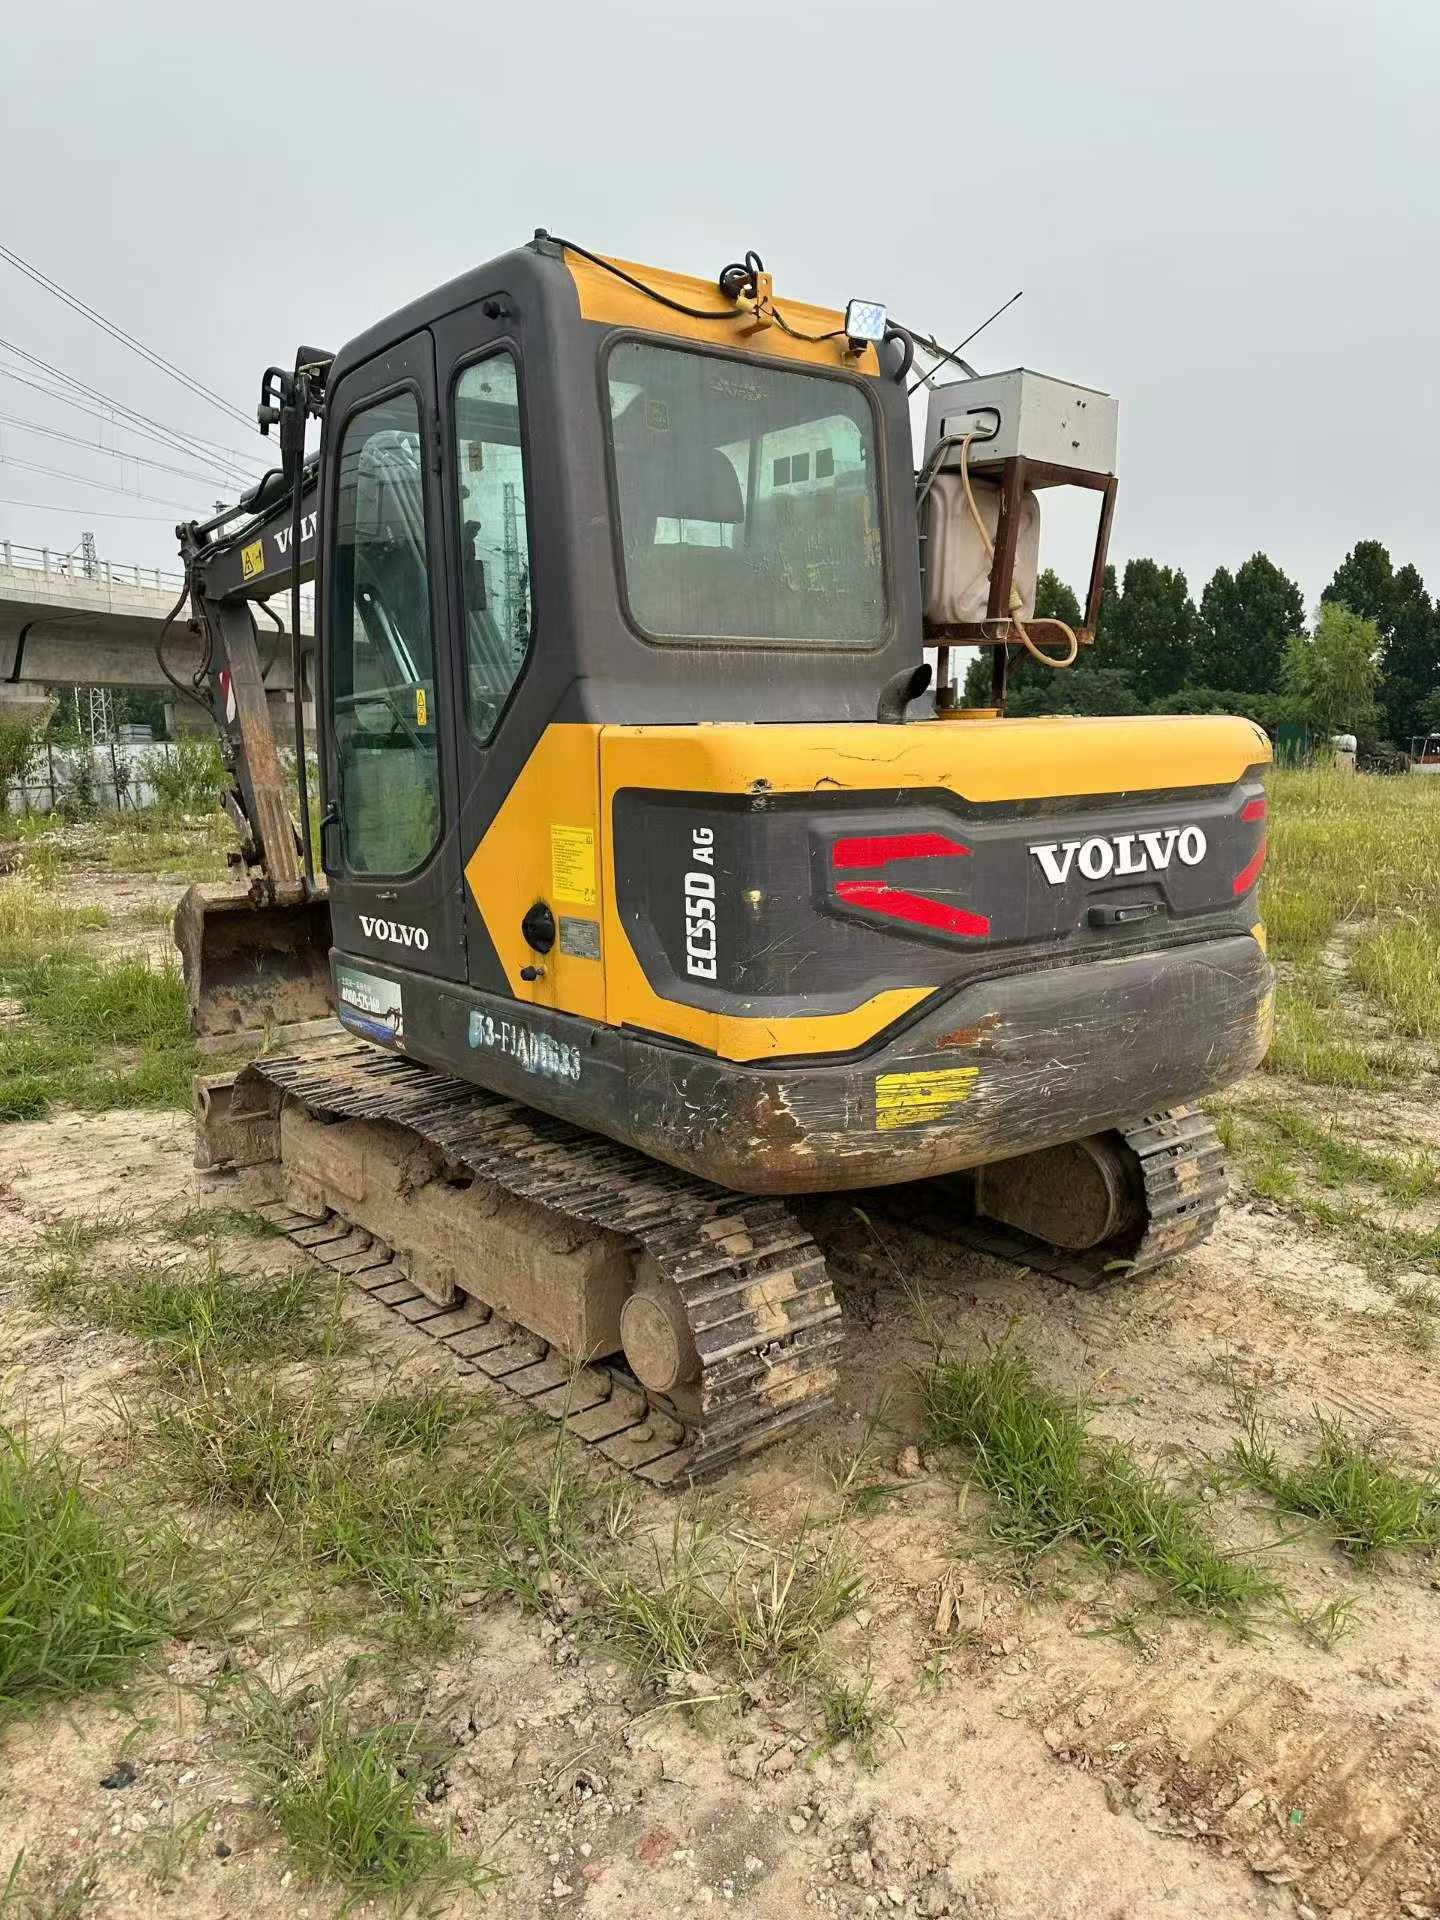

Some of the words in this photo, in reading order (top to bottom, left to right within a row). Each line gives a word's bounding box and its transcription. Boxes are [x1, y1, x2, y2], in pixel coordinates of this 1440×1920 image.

[274, 511, 317, 553] VLV
[692, 827, 714, 866] AG
[1029, 826, 1207, 885] VOLVO
[359, 915, 429, 950] VOLVO
[684, 872, 717, 980] EC55D
